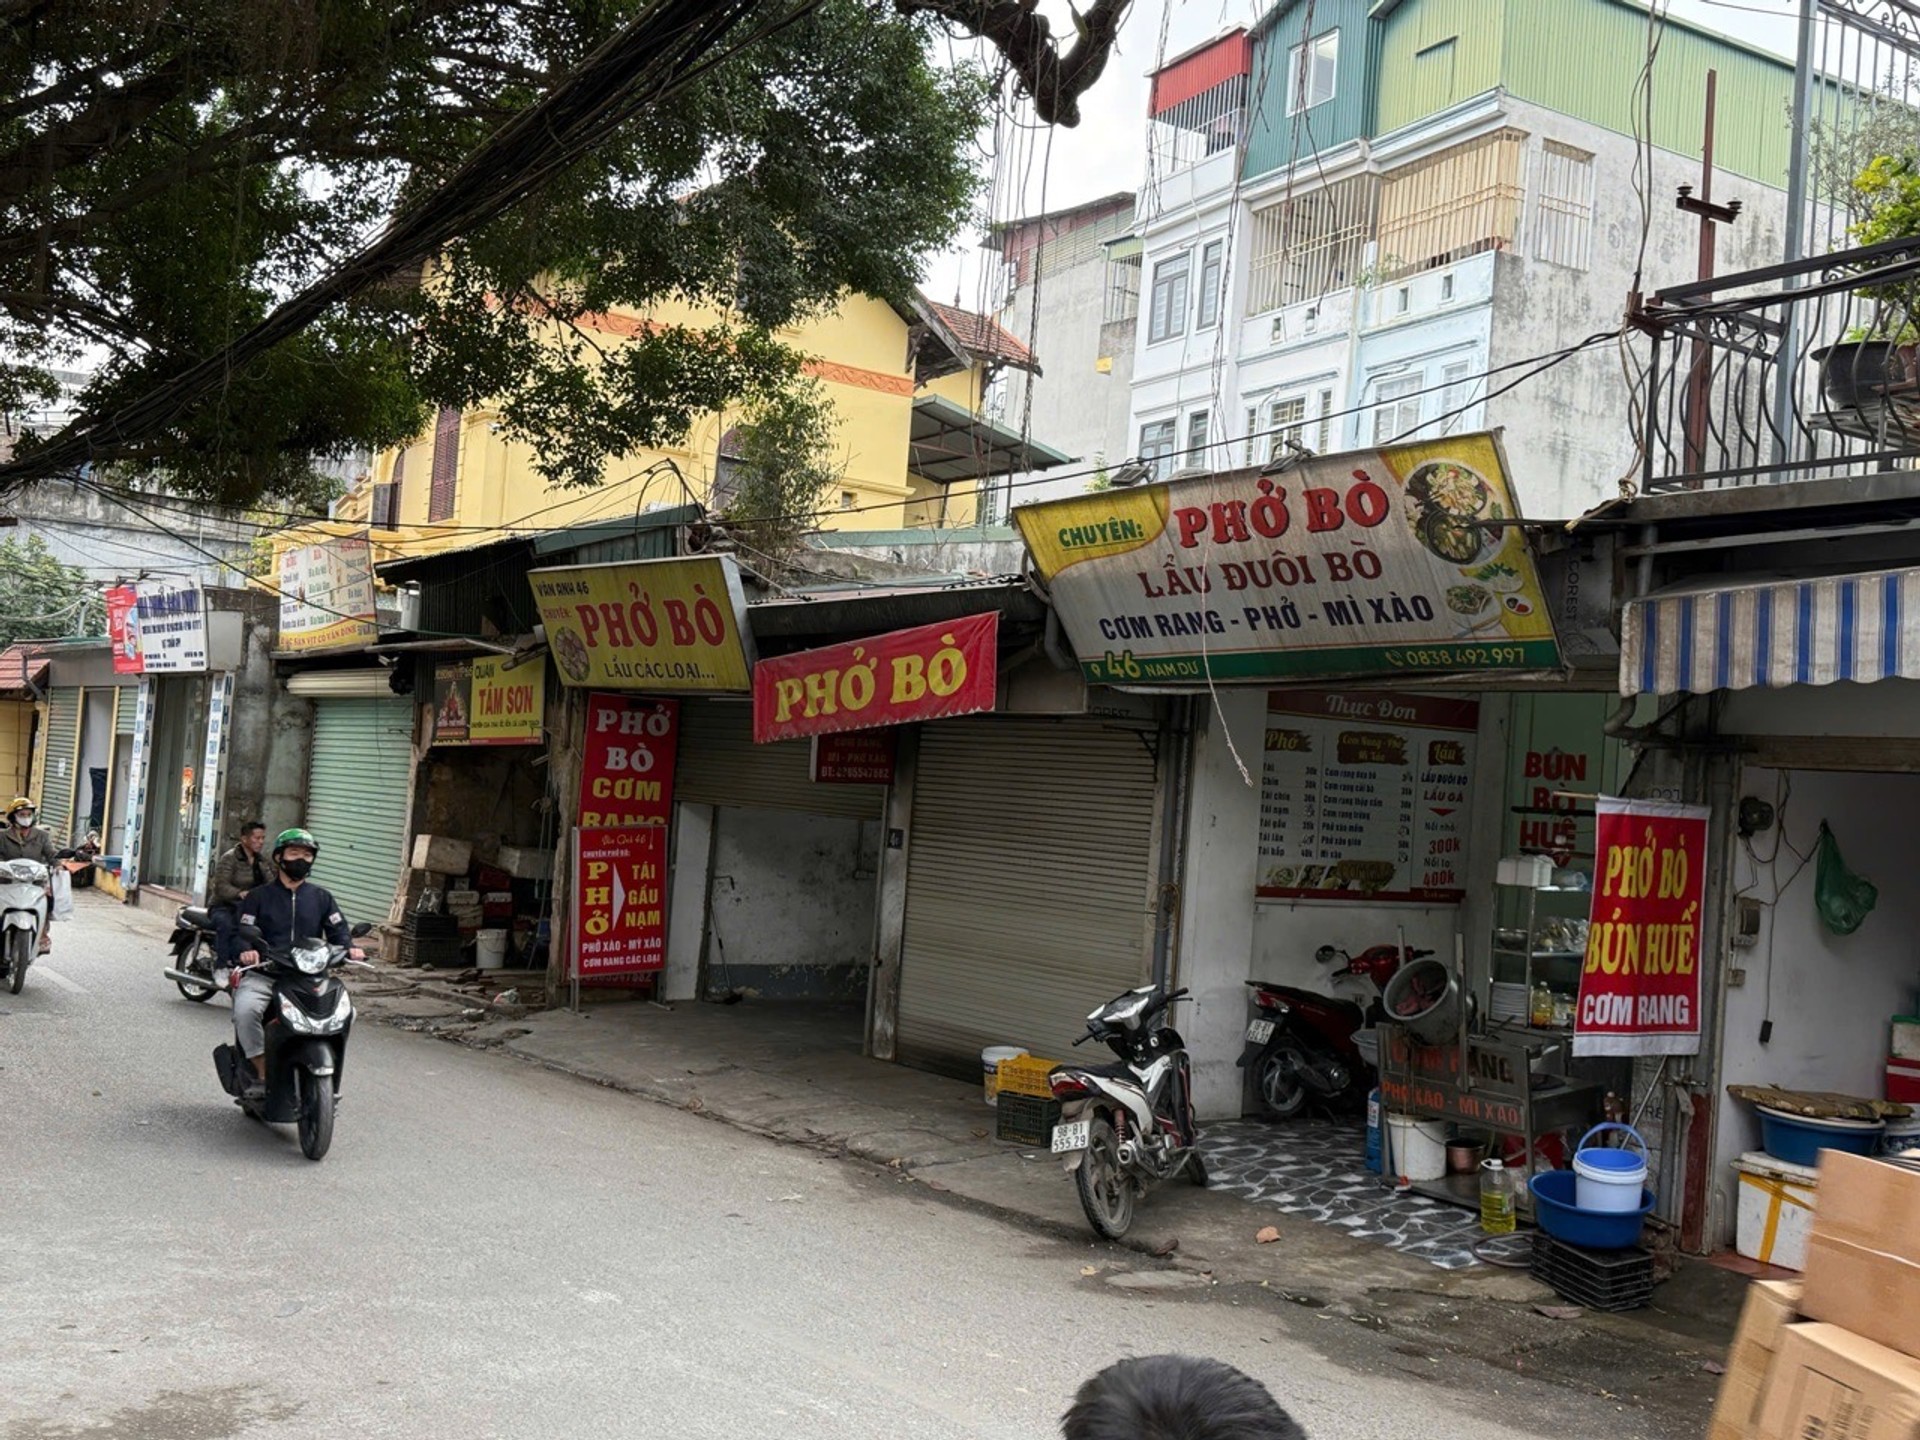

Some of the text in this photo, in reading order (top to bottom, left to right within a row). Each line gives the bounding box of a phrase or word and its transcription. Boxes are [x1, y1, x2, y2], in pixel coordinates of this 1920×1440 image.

[1174, 469, 1390, 549] PHỞ BÒ
[1058, 517, 1145, 548] CHUYÊN:
[1137, 540, 1383, 599] LẨU ĐUÔI BÒ
[576, 581, 590, 596] 46
[575, 582, 726, 648] PHỞ BÒ
[1099, 613, 1154, 641] CƠM
[1158, 608, 1226, 637] RANG
[1242, 595, 1301, 632] PHỞ
[1322, 594, 1364, 628] MÌ
[1366, 590, 1435, 624] XÀO
[634, 657, 664, 678] CÁC
[1103, 651, 1141, 680] 46
[1146, 662, 1177, 679] NAM
[1406, 648, 1525, 666] 0838 492 997
[775, 633, 967, 722] PHỞ BÒ
[479, 681, 534, 716] TÂM SƠN
[596, 703, 671, 737] PHỞ
[605, 742, 654, 773] BÒ
[592, 777, 662, 802] CƠM
[1428, 837, 1462, 856] 300k
[632, 861, 656, 880] TÁI
[1602, 825, 1688, 900] PHỞ BÒ
[1423, 870, 1455, 889] 400k
[625, 910, 661, 931] NẠM
[582, 939, 601, 954] PHỞ
[1585, 900, 1698, 975] BÚN HUẾ
[1582, 991, 1690, 1026] CƠM RANG
